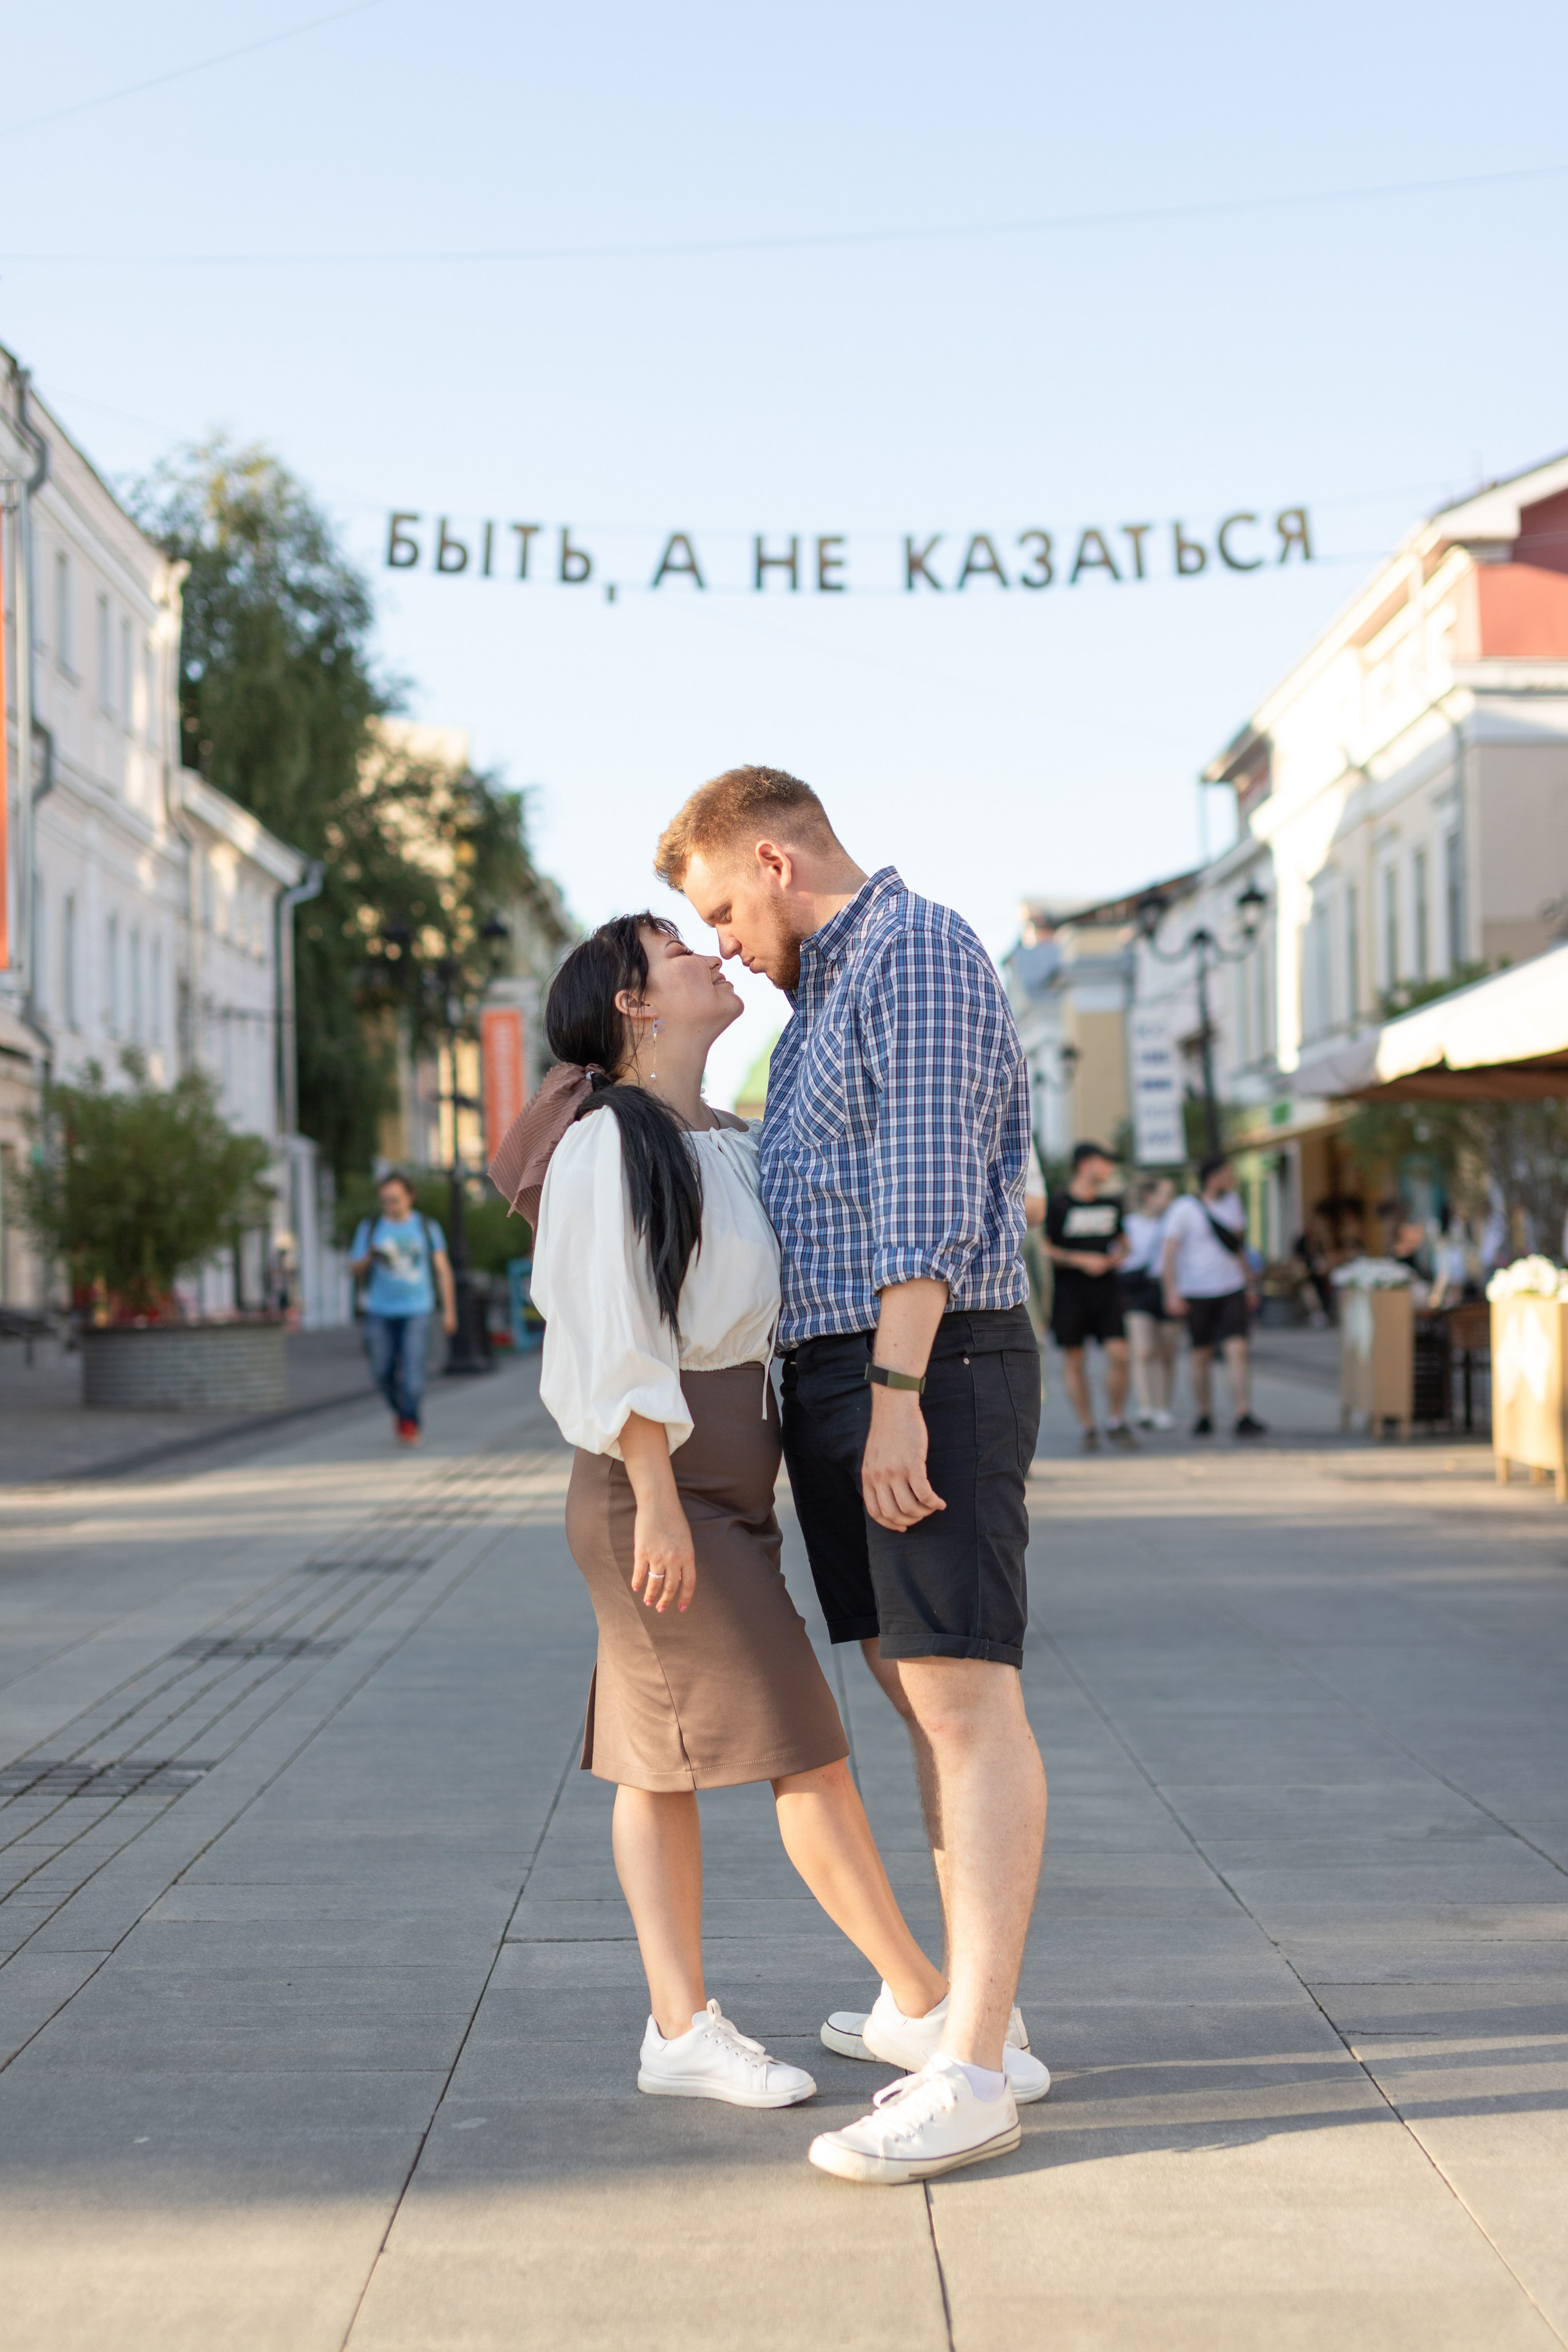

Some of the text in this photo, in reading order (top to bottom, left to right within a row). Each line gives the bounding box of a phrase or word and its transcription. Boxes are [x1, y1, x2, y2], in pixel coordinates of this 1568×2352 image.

[383, 506, 1314, 604] БЫТЬ, А НЕ КАЗАТЬСЯ
